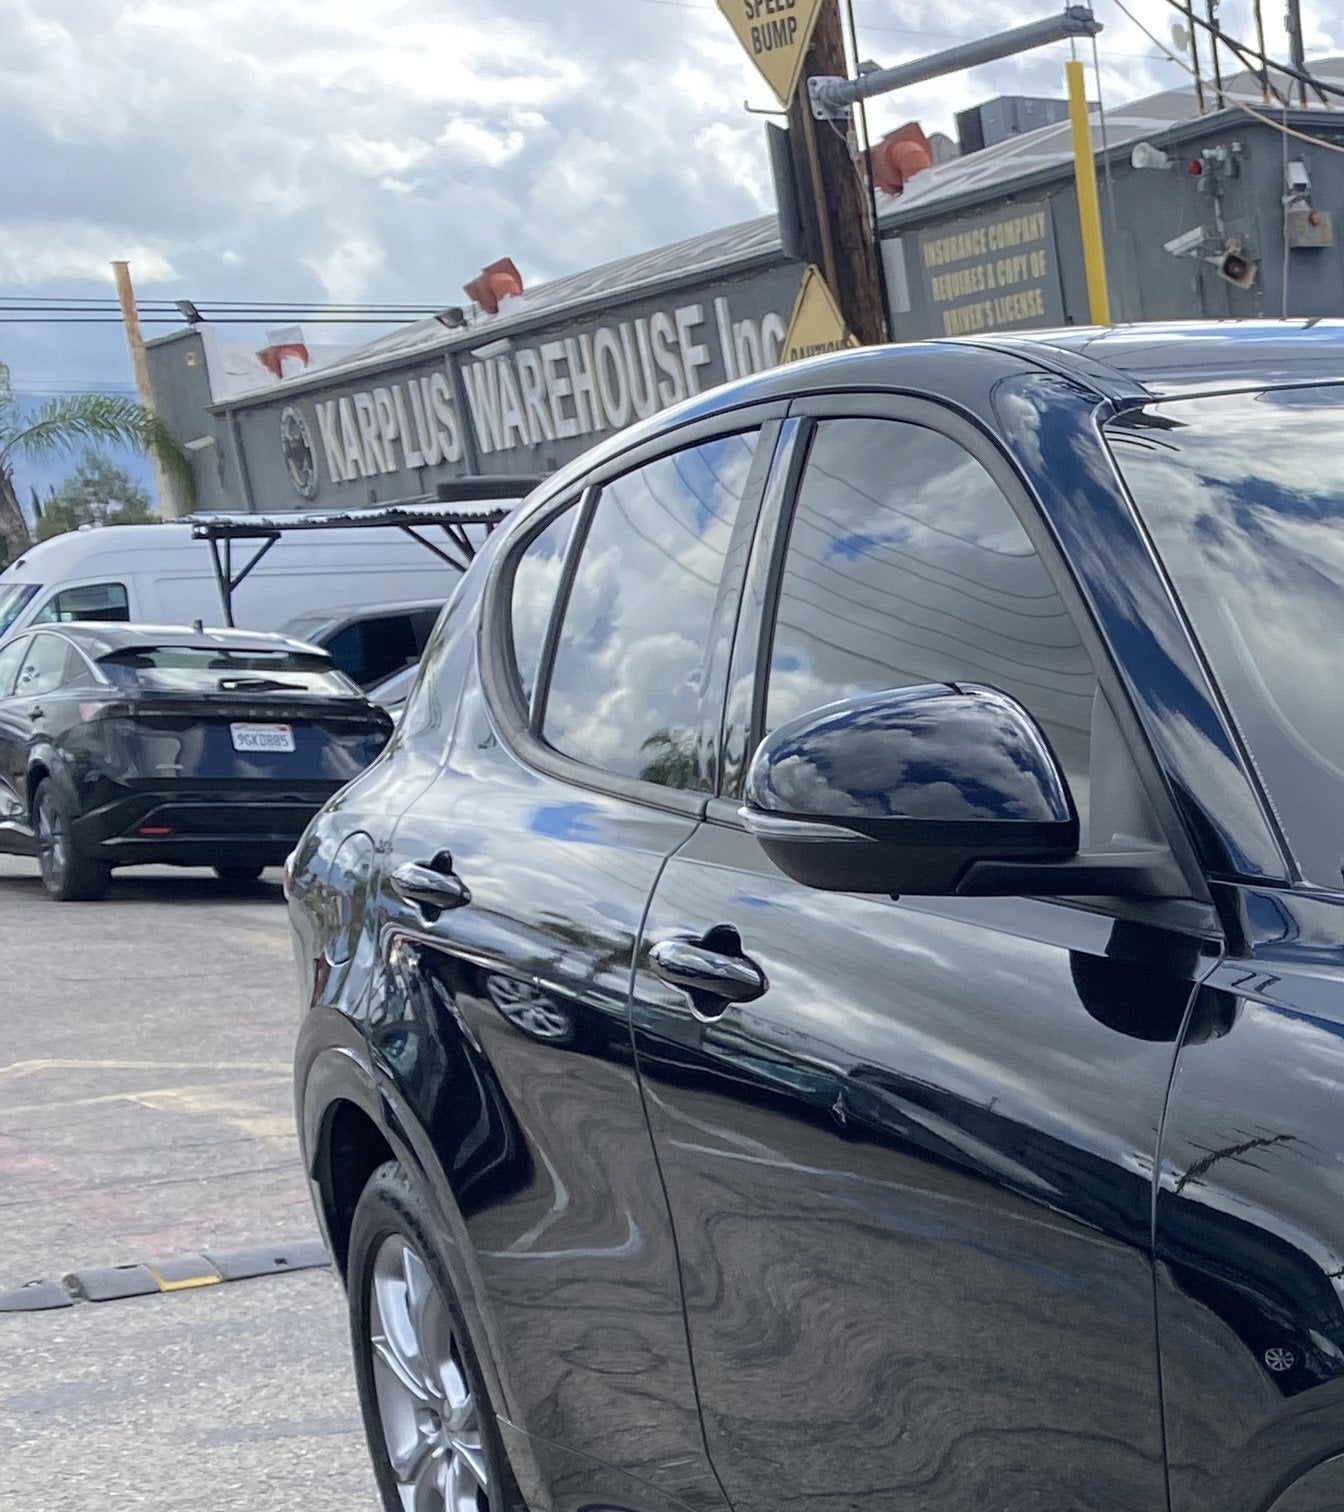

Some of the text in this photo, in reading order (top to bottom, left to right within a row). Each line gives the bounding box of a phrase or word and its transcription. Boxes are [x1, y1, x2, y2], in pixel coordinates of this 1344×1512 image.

[751, 16, 797, 55] BUMP
[923, 211, 1046, 269] INSURANCE COMPANY
[931, 250, 1046, 302] REQUIRES A COPY OF
[994, 288, 1045, 325] LICENSE
[315, 372, 463, 483] KARPLUS
